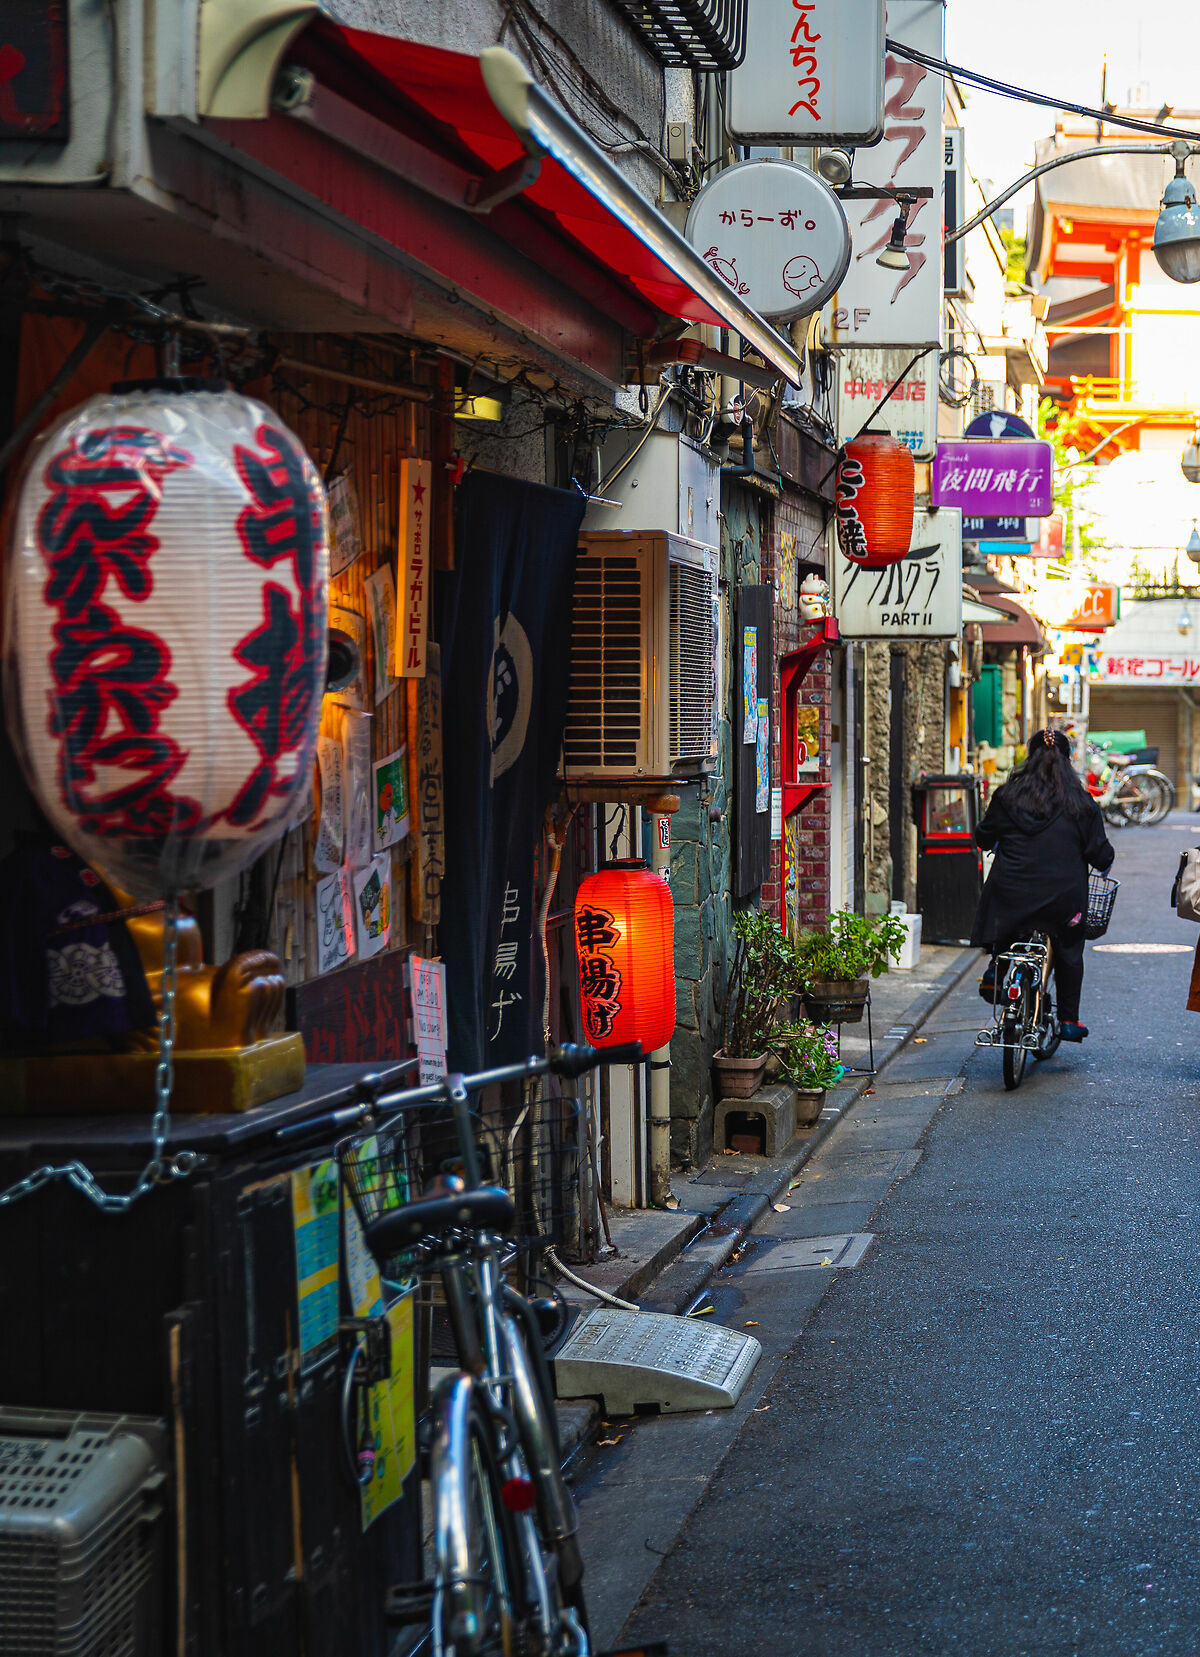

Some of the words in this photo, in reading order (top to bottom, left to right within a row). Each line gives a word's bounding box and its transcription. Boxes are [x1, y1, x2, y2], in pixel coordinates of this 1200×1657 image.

[719, 209, 816, 230] からーず。
[834, 307, 871, 331] 2F
[844, 379, 926, 400] 中村酒店
[940, 468, 1044, 492] 夜間飛行
[1072, 590, 1104, 618] CC
[881, 613, 920, 626] PART
[923, 613, 932, 626] II
[576, 905, 622, 1039] 串揚げ
